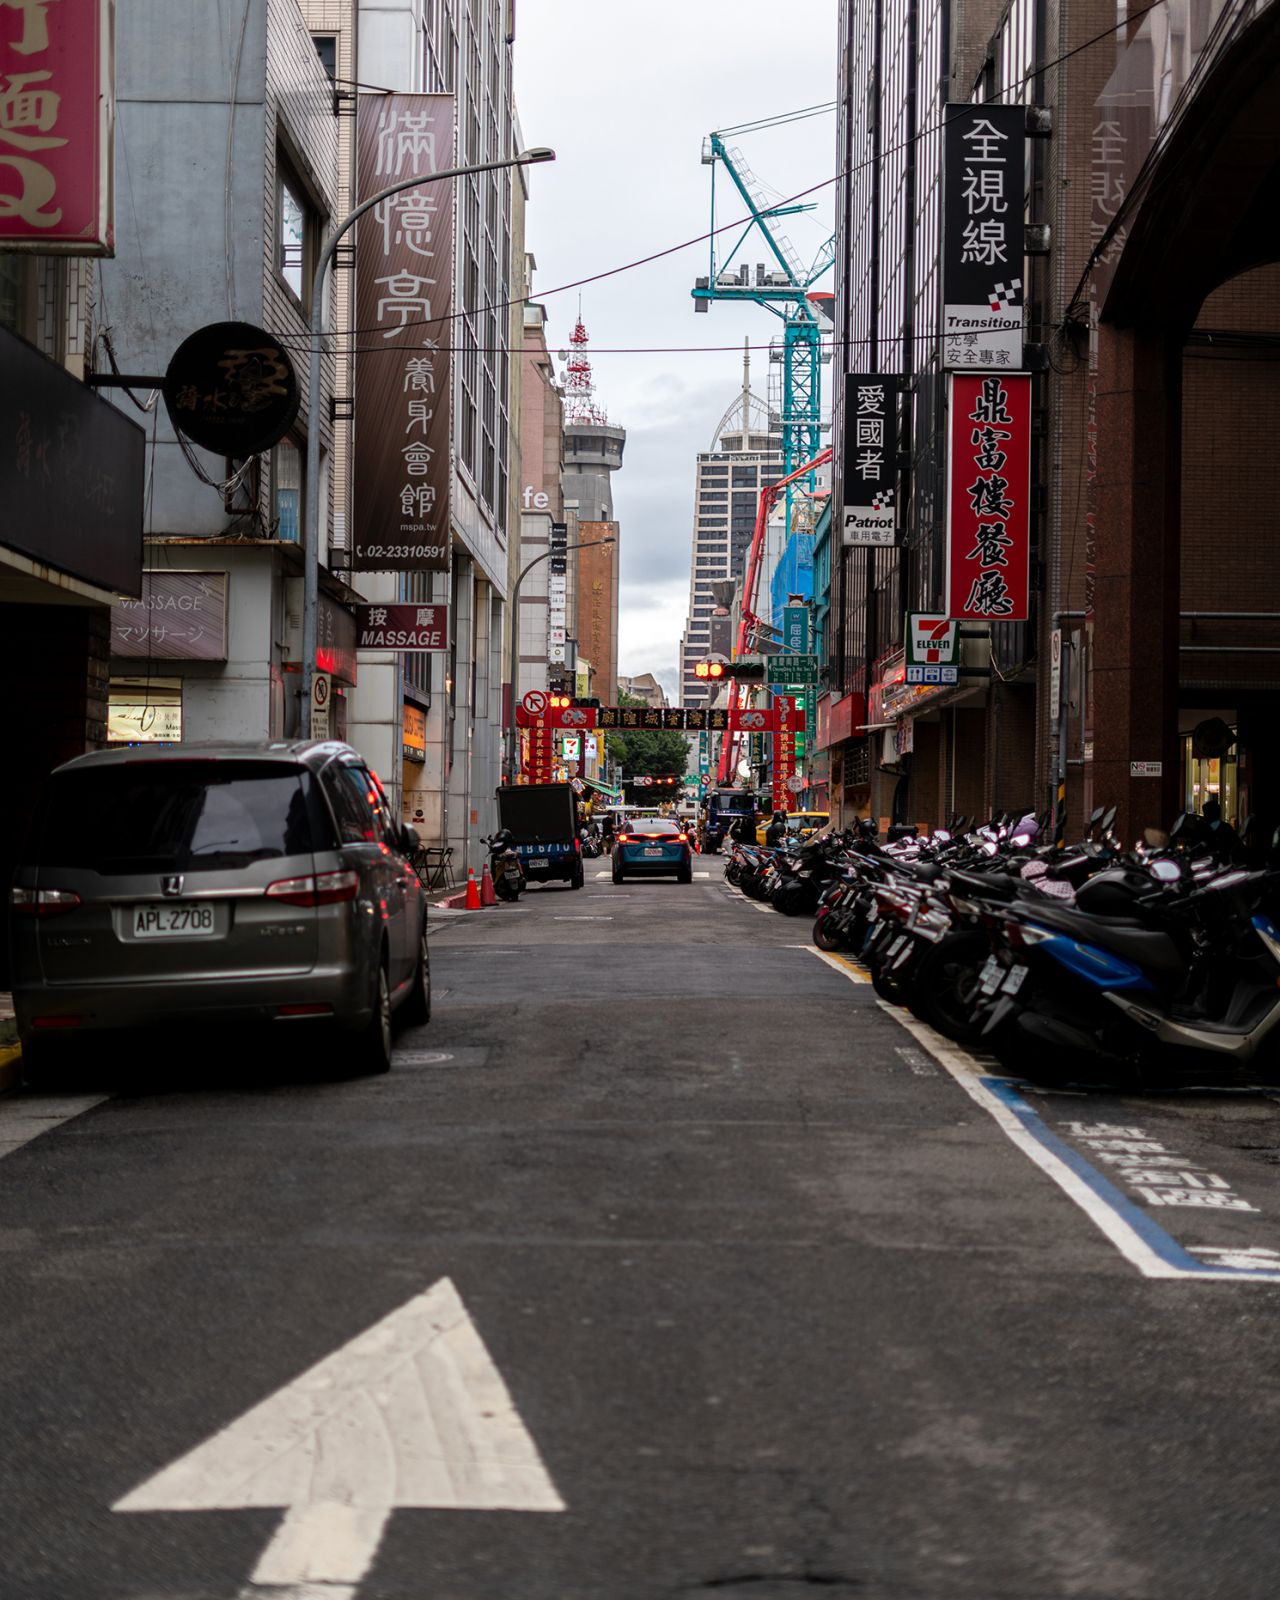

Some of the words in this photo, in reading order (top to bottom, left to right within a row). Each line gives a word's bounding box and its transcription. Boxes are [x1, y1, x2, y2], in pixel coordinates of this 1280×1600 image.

[960, 118, 1010, 267] 全視線
[947, 316, 1021, 329] Transition
[947, 331, 978, 347] 光學
[947, 348, 1010, 365] 安全專家
[400, 357, 436, 518] 養身會館
[855, 384, 886, 481] 愛國者
[521, 486, 549, 509] fe
[964, 377, 1014, 616] 鼎富樓餐廳
[400, 522, 437, 533] mspa.tw
[845, 514, 894, 528] Patriot
[849, 531, 892, 542] 車用電子
[367, 545, 446, 559] 02-23310591
[360, 630, 442, 647] MASSAGE
[136, 909, 212, 932] APL-2708
